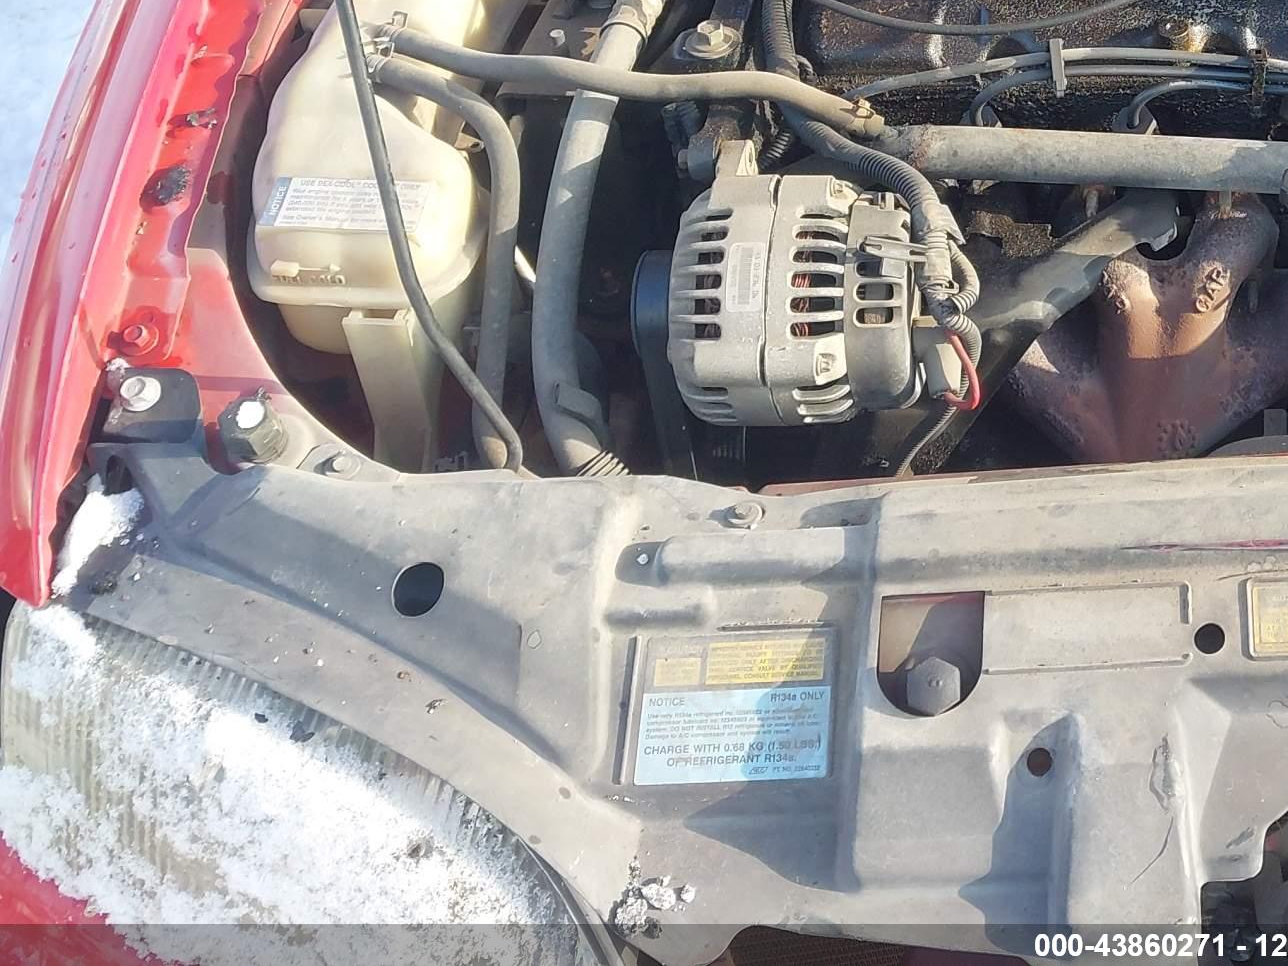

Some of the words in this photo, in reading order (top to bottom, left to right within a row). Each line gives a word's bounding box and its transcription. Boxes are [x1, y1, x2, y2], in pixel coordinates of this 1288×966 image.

[268, 185, 288, 216] NOTICE
[648, 697, 686, 707] NOTICE
[770, 692, 797, 703] R134a
[800, 691, 825, 701] ONLY
[644, 744, 690, 755] CHARGE
[693, 743, 721, 753] WITH
[723, 742, 745, 752] 0.68
[748, 741, 764, 751] KG
[684, 754, 761, 767] REFRIGERANT
